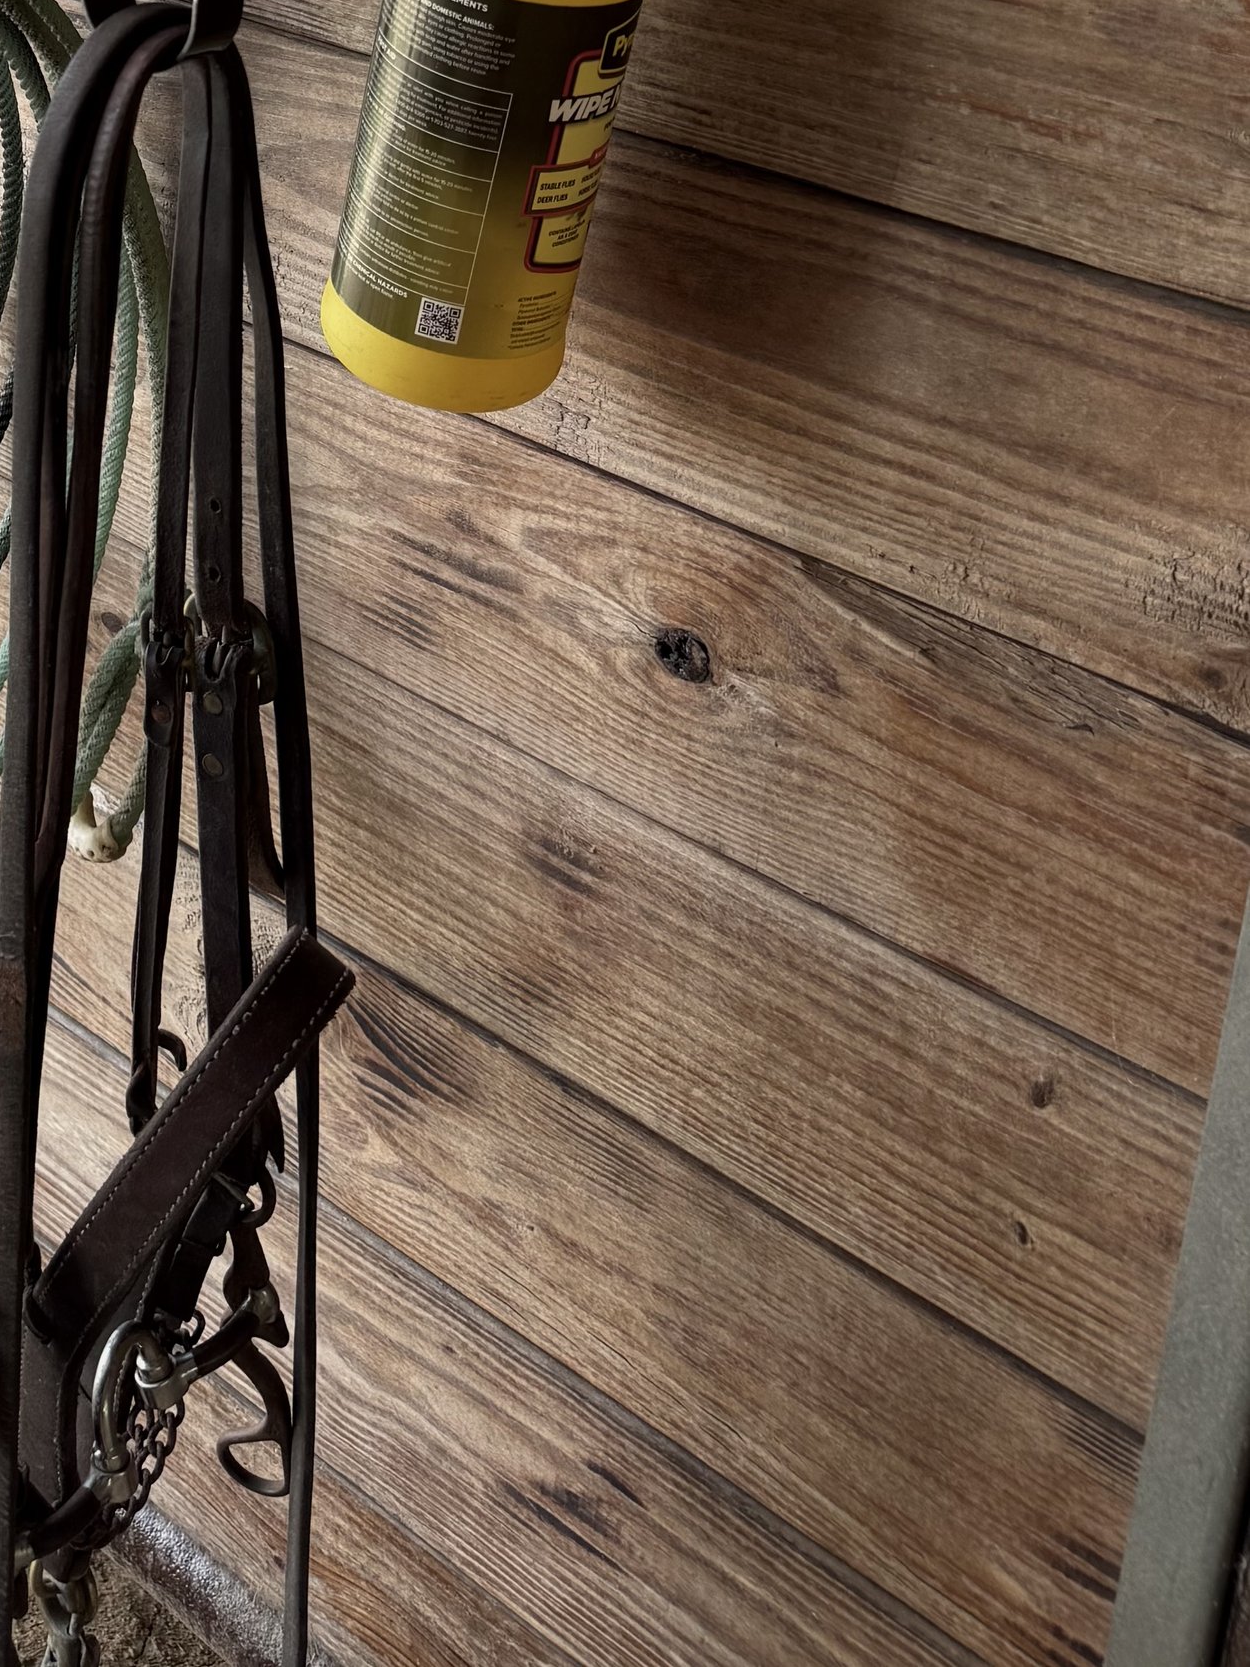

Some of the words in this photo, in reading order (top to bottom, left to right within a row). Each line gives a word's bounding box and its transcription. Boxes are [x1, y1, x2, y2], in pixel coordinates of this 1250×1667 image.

[432, 3, 462, 22] DOMESTIC
[462, 16, 495, 31] ANIMALS:
[548, 87, 616, 123] WIPE
[540, 181, 562, 191] STABLE
[561, 179, 576, 190] FLIES
[537, 195, 553, 204] DEER
[553, 193, 568, 203] FLIES
[378, 276, 408, 299] HAZARDS
